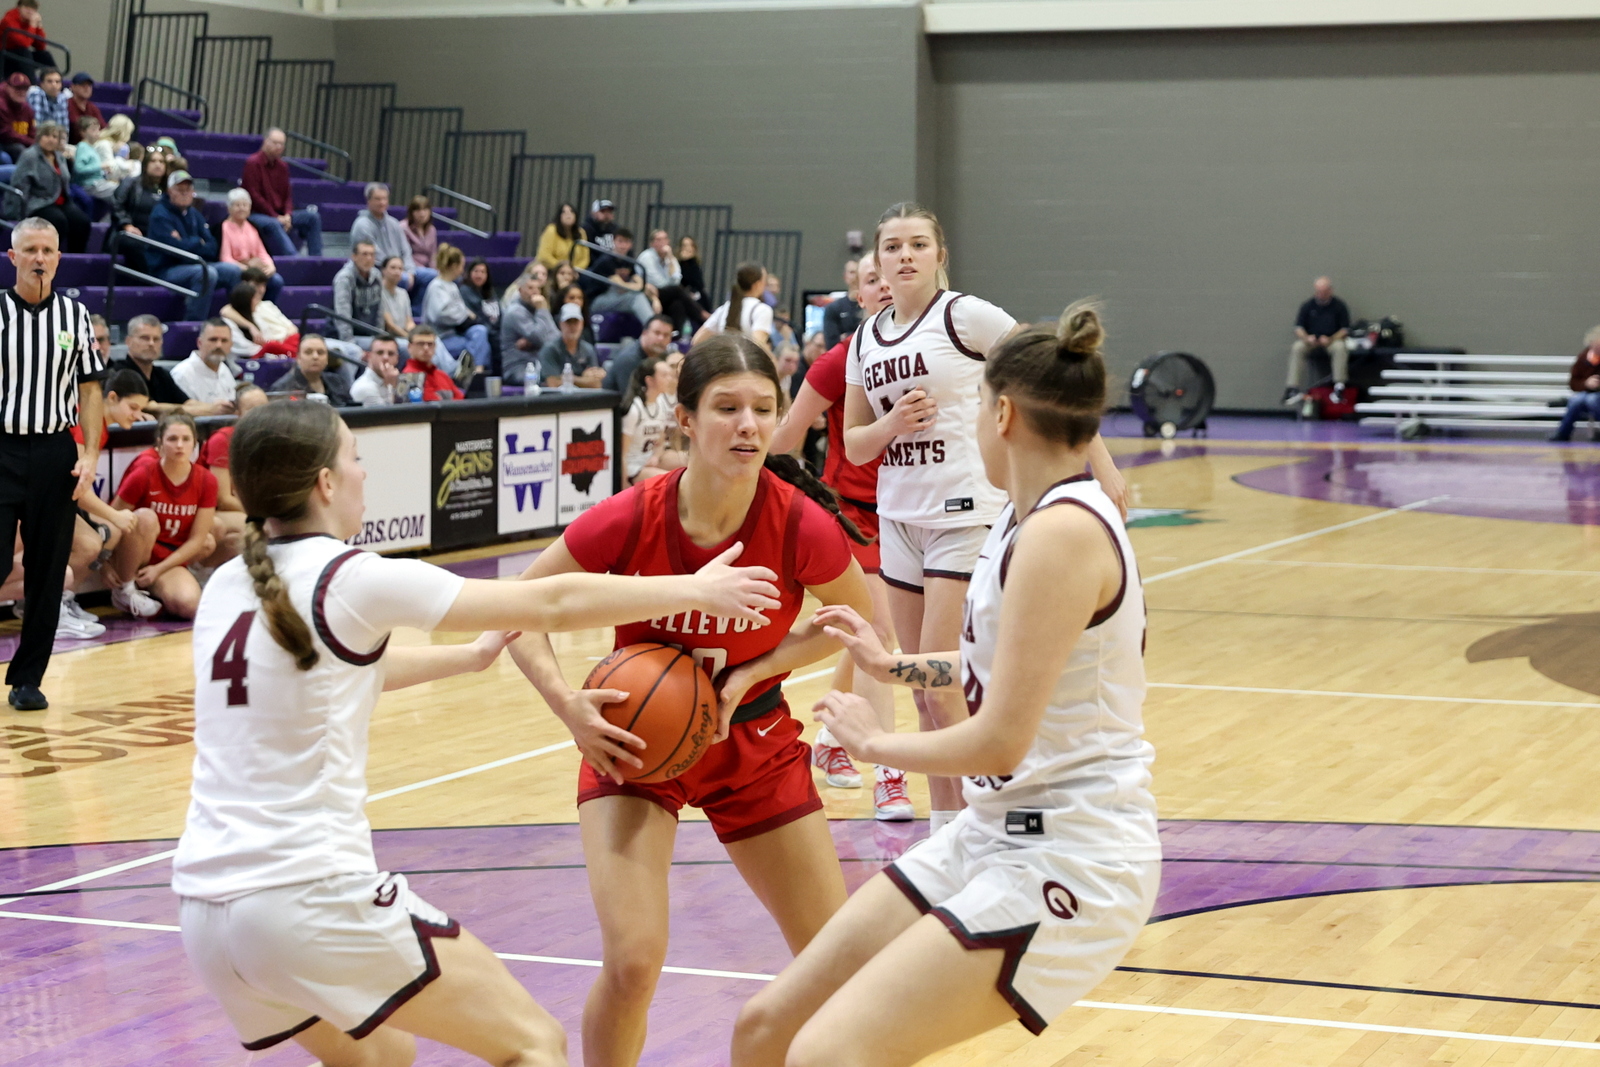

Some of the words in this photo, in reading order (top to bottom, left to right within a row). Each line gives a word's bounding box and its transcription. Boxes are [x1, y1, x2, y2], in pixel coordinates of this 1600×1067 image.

[864, 352, 929, 392] GENOA
[882, 439, 945, 467] METS
[344, 514, 426, 546] ERS.COM
[640, 606, 766, 635] ELLEVUE
[210, 610, 258, 707] 4
[664, 702, 714, 779] Rawlings
